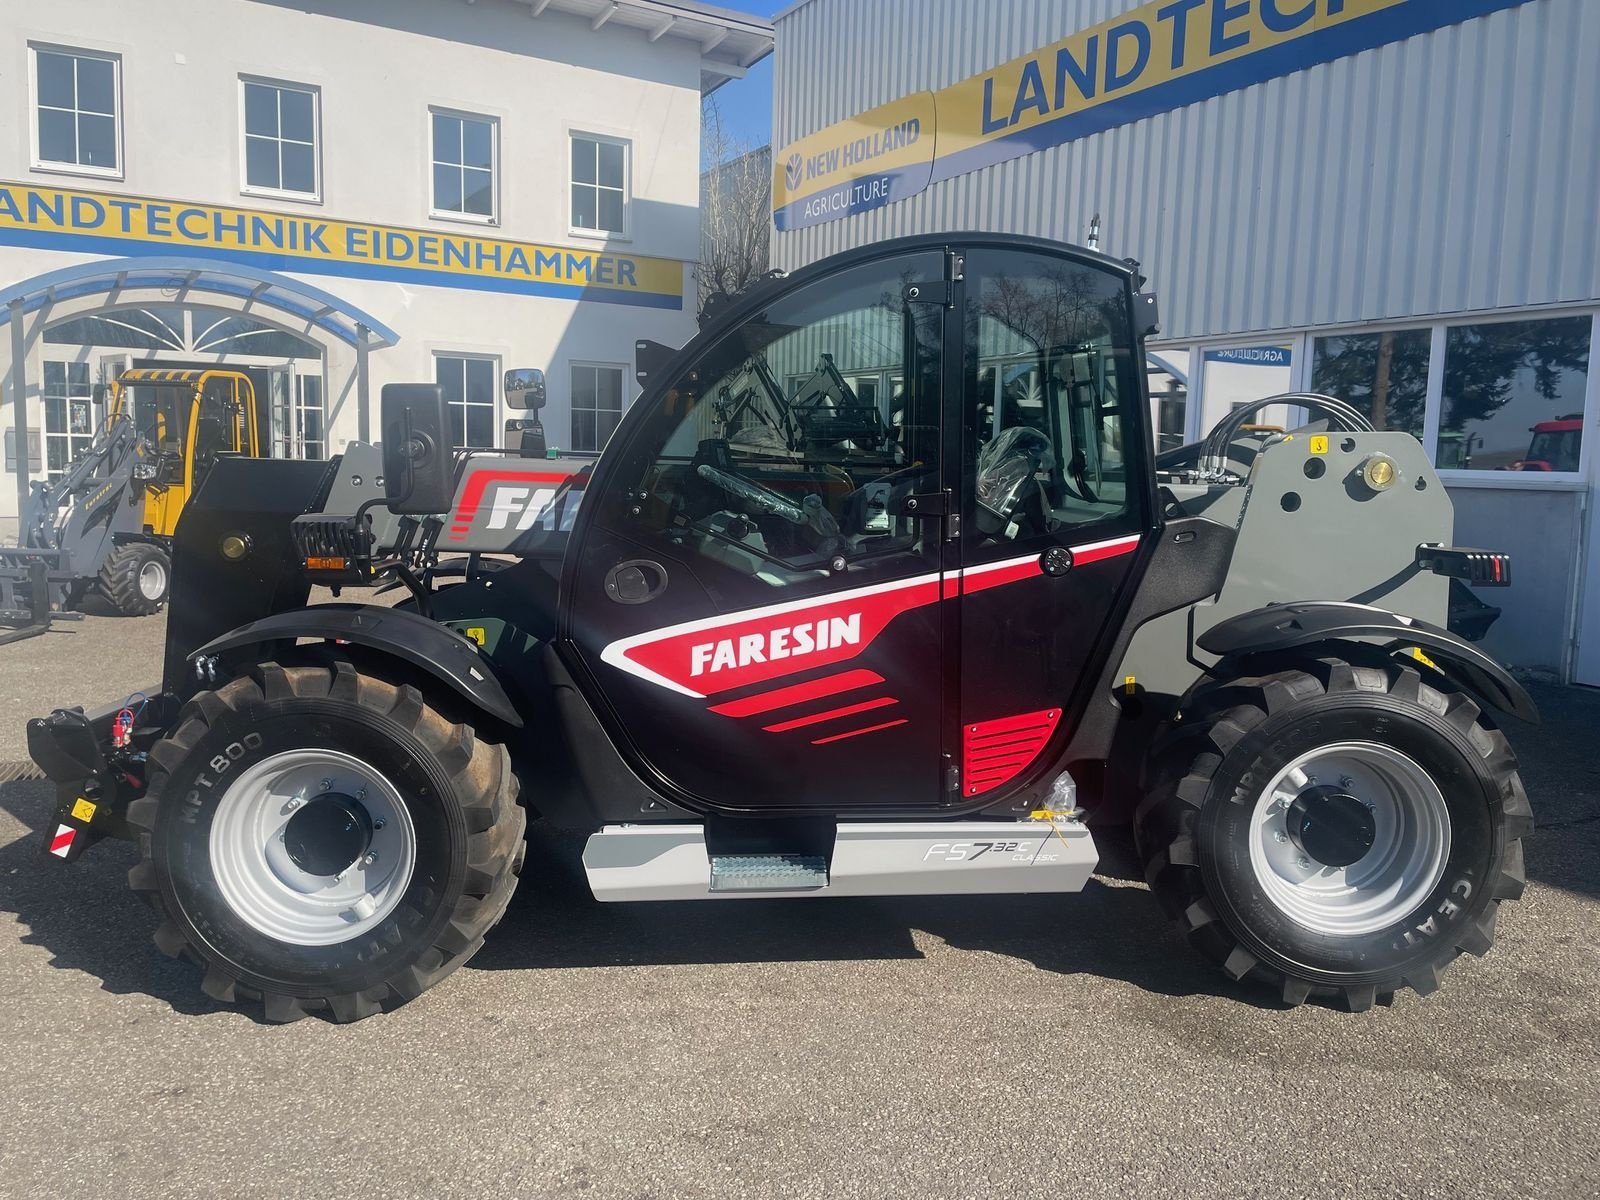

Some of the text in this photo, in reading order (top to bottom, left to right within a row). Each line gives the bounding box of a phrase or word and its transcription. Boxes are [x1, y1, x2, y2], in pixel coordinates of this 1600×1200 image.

[982, 0, 1344, 135] LANDTE
[806, 118, 920, 180] NEW HOLLAND
[804, 177, 888, 219] AGRICULTURE
[345, 226, 637, 287] EIDENHAMMER
[690, 612, 862, 677] FARESIN
[182, 732, 263, 823] MPT 800
[1012, 854, 1059, 862] CLASSIC
[1403, 879, 1473, 948] CEAT
